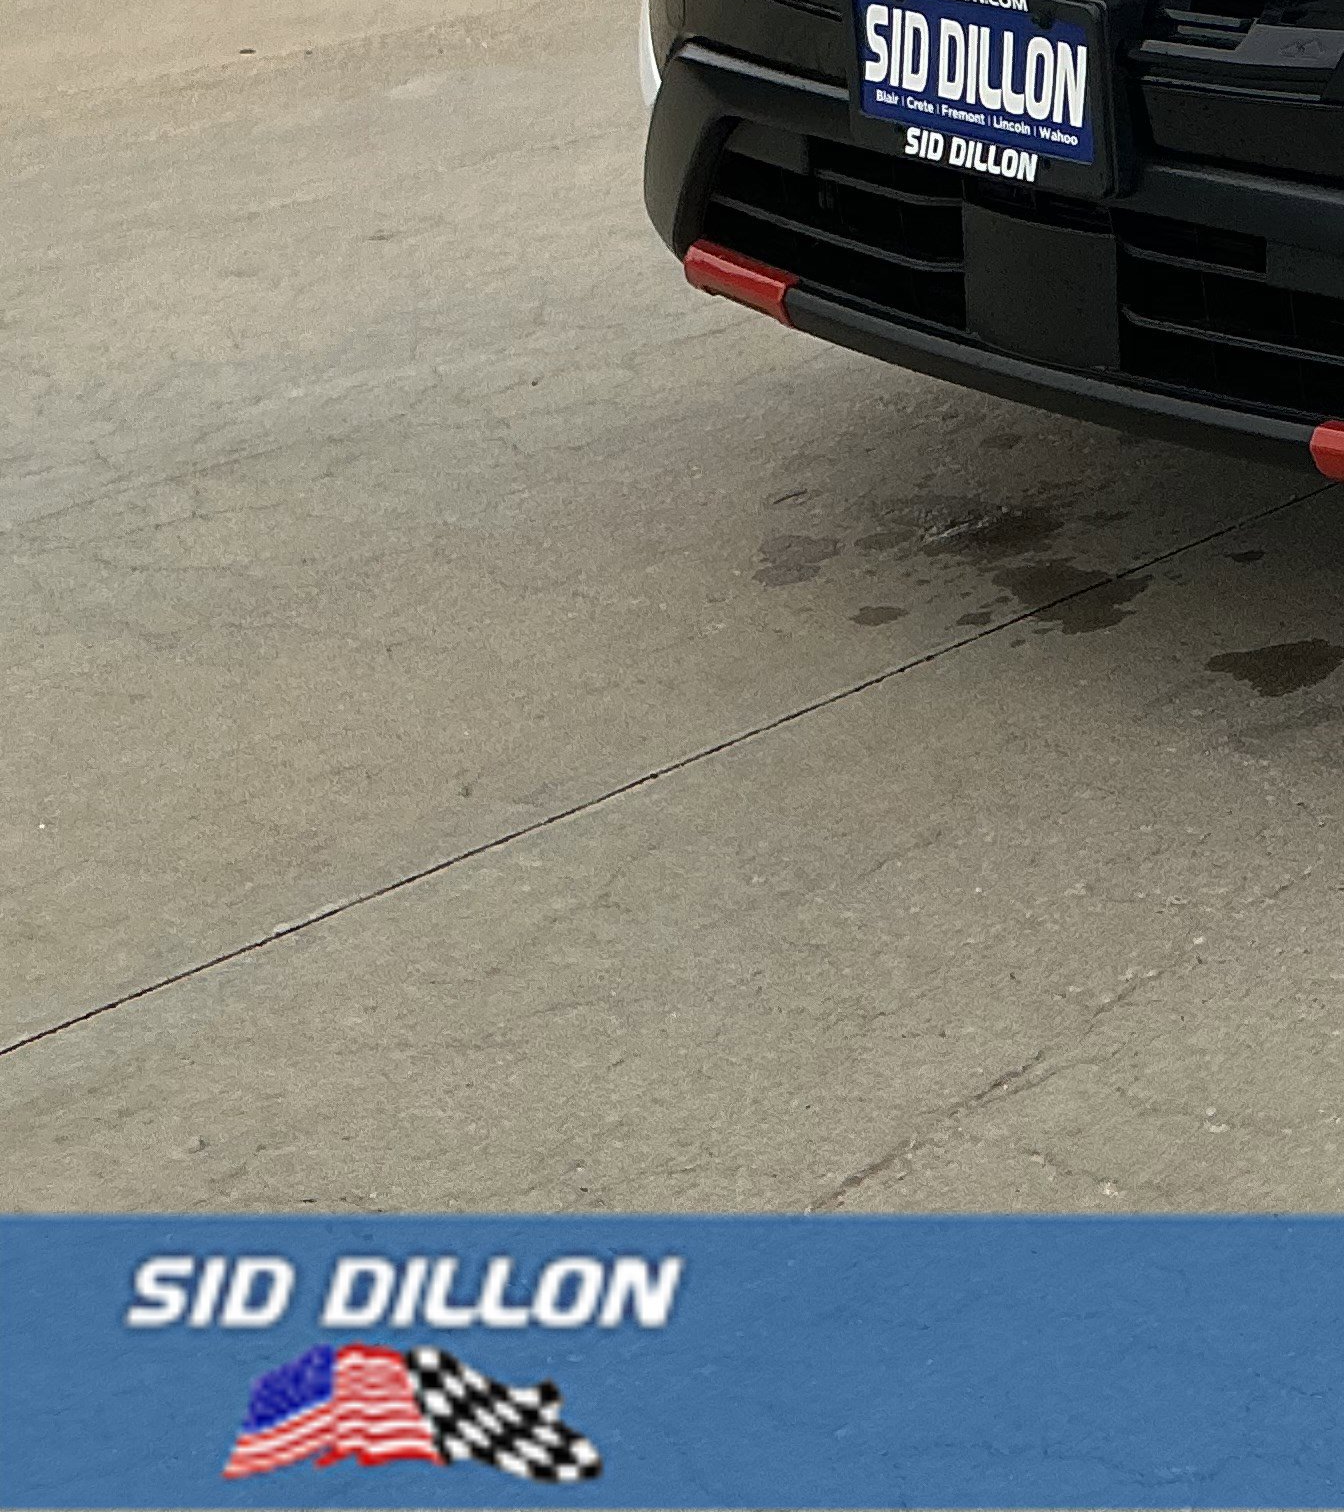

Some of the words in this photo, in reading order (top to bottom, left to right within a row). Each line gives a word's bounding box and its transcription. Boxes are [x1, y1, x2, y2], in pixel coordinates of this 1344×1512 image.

[865, 3, 930, 93] SID
[937, 17, 1088, 128] DILLON
[876, 89, 900, 105] Blair
[906, 96, 934, 114] Crete
[941, 104, 985, 125] Fremont
[993, 116, 1031, 135] Lincoln
[1039, 126, 1078, 146] Wahoo
[905, 127, 944, 161] SID
[948, 137, 1038, 182] DILLON
